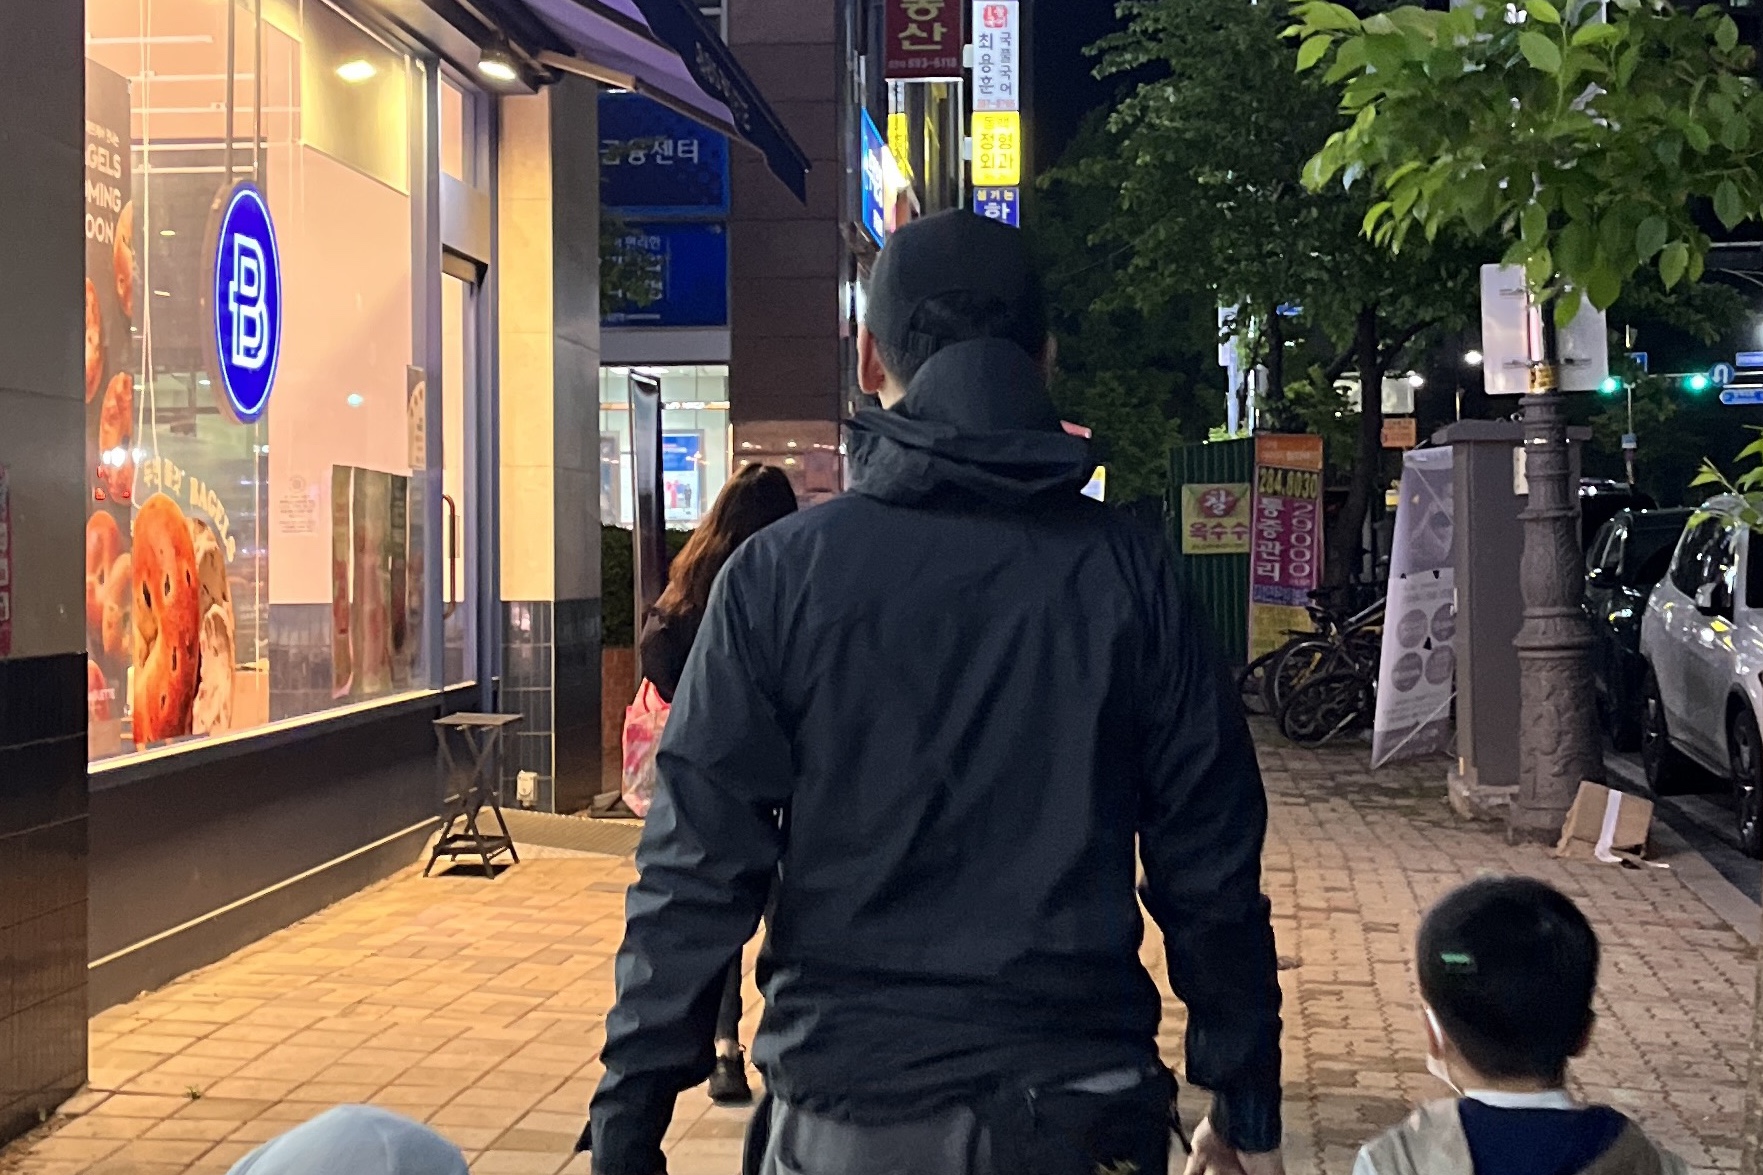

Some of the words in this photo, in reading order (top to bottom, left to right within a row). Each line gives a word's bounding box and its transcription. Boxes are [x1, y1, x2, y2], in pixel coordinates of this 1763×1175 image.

[978, 32, 994, 94] 최용훈
[981, 133, 1013, 150] 정형
[85, 143, 121, 178] GELS
[981, 153, 1014, 169] 외과
[85, 179, 121, 212] MING
[1190, 522, 1249, 541] 옥수수
